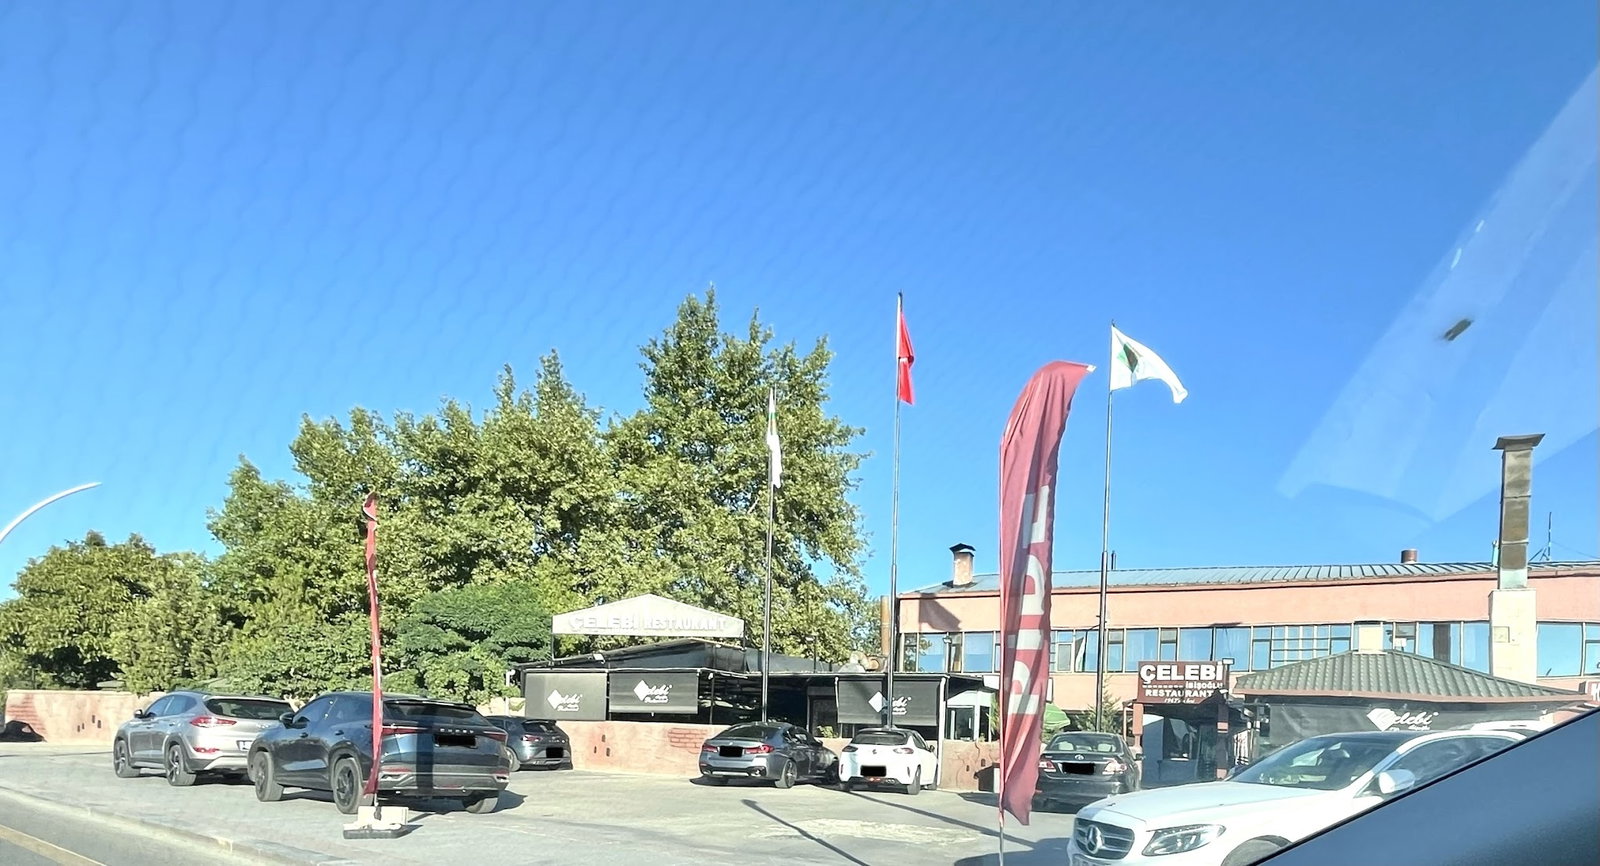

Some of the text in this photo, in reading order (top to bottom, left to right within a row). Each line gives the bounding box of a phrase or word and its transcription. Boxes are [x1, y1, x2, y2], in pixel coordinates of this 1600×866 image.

[643, 616, 726, 631] RESTAURANT
[1140, 661, 1224, 684] ÇELEBİ
[1145, 688, 1214, 697] RESTAURANT
